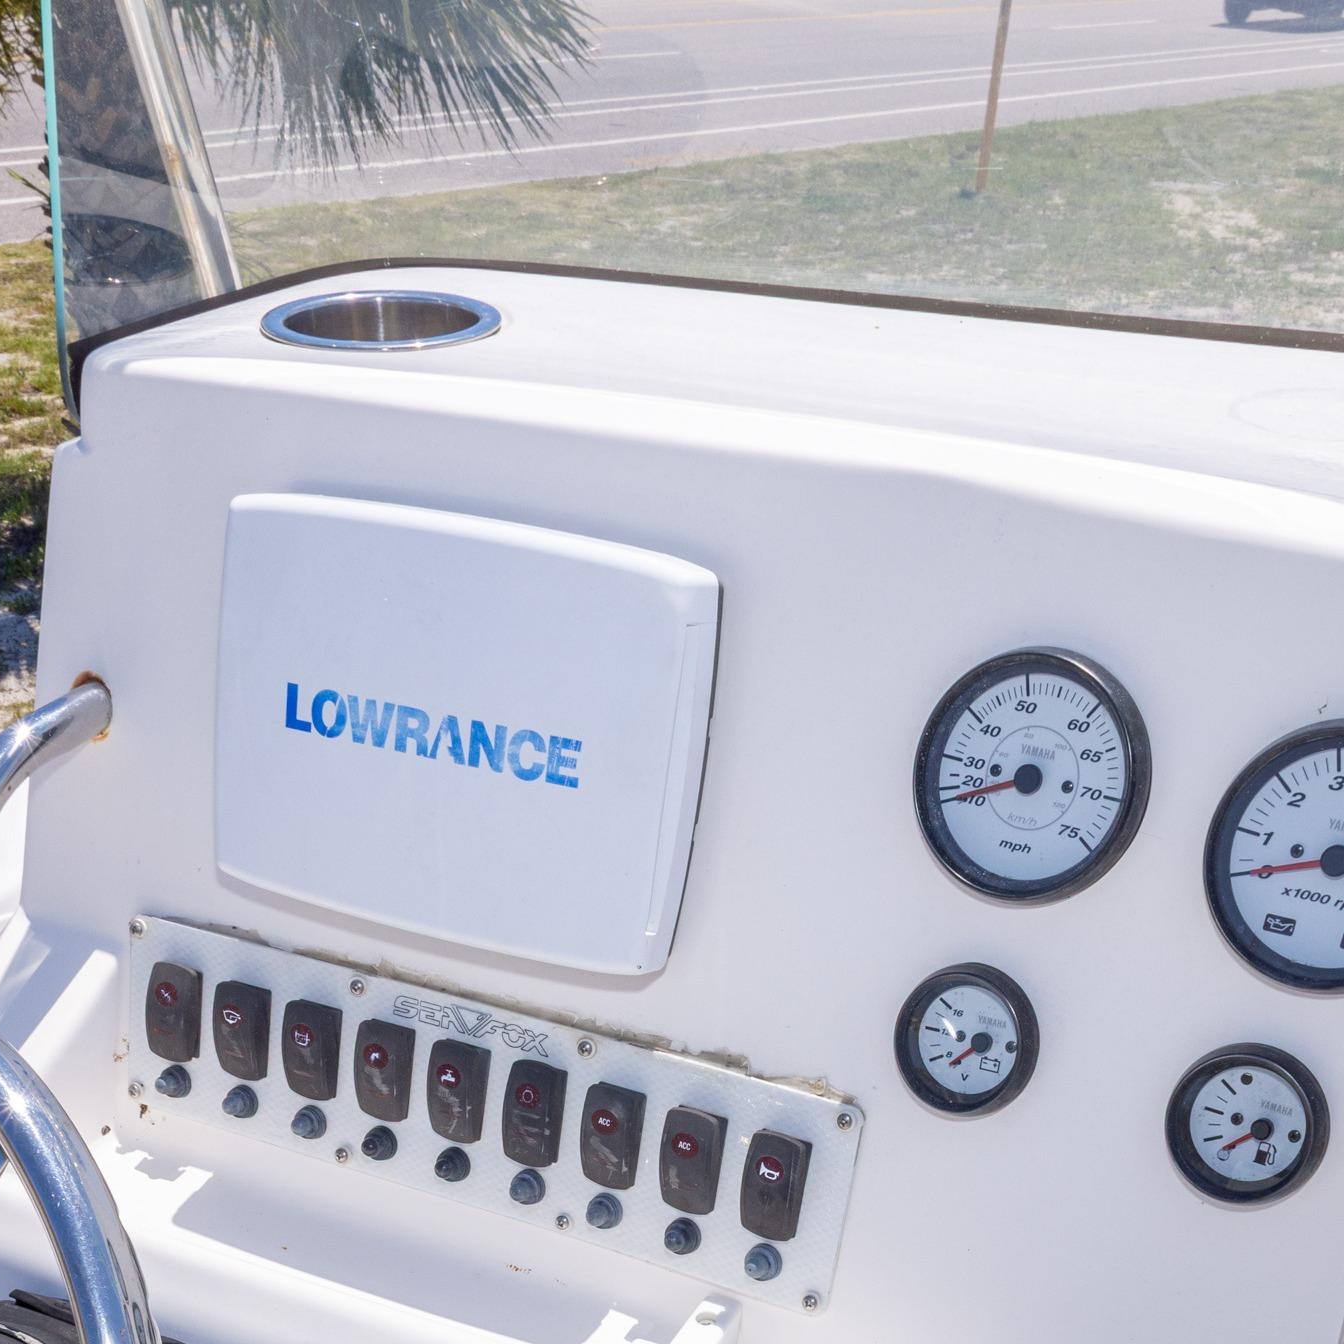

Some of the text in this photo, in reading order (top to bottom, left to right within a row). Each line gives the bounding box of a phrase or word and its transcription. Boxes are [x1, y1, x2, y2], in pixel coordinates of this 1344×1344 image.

[1014, 700, 1038, 714] 50
[979, 724, 1002, 738] 40
[1067, 718, 1091, 733] 60
[285, 682, 582, 789] LOWRANCE
[1021, 743, 1055, 761] YAMAHA
[1079, 749, 1103, 763] 65
[964, 756, 986, 770] 30
[961, 775, 984, 788] 20
[1079, 786, 1103, 801] 70
[1287, 792, 1306, 808] 2
[1007, 812, 1037, 827] km/h
[1058, 824, 1081, 839] 75
[1262, 831, 1275, 846] 1
[999, 839, 1032, 854] mph
[1281, 887, 1332, 906] x1000
[952, 1009, 964, 1018] 16
[978, 1015, 1007, 1029] YAMAHA
[961, 1073, 969, 1081] V
[1260, 1100, 1293, 1117] YAMAHA
[598, 1117, 611, 1127] ACC
[678, 1141, 691, 1151] ACC
